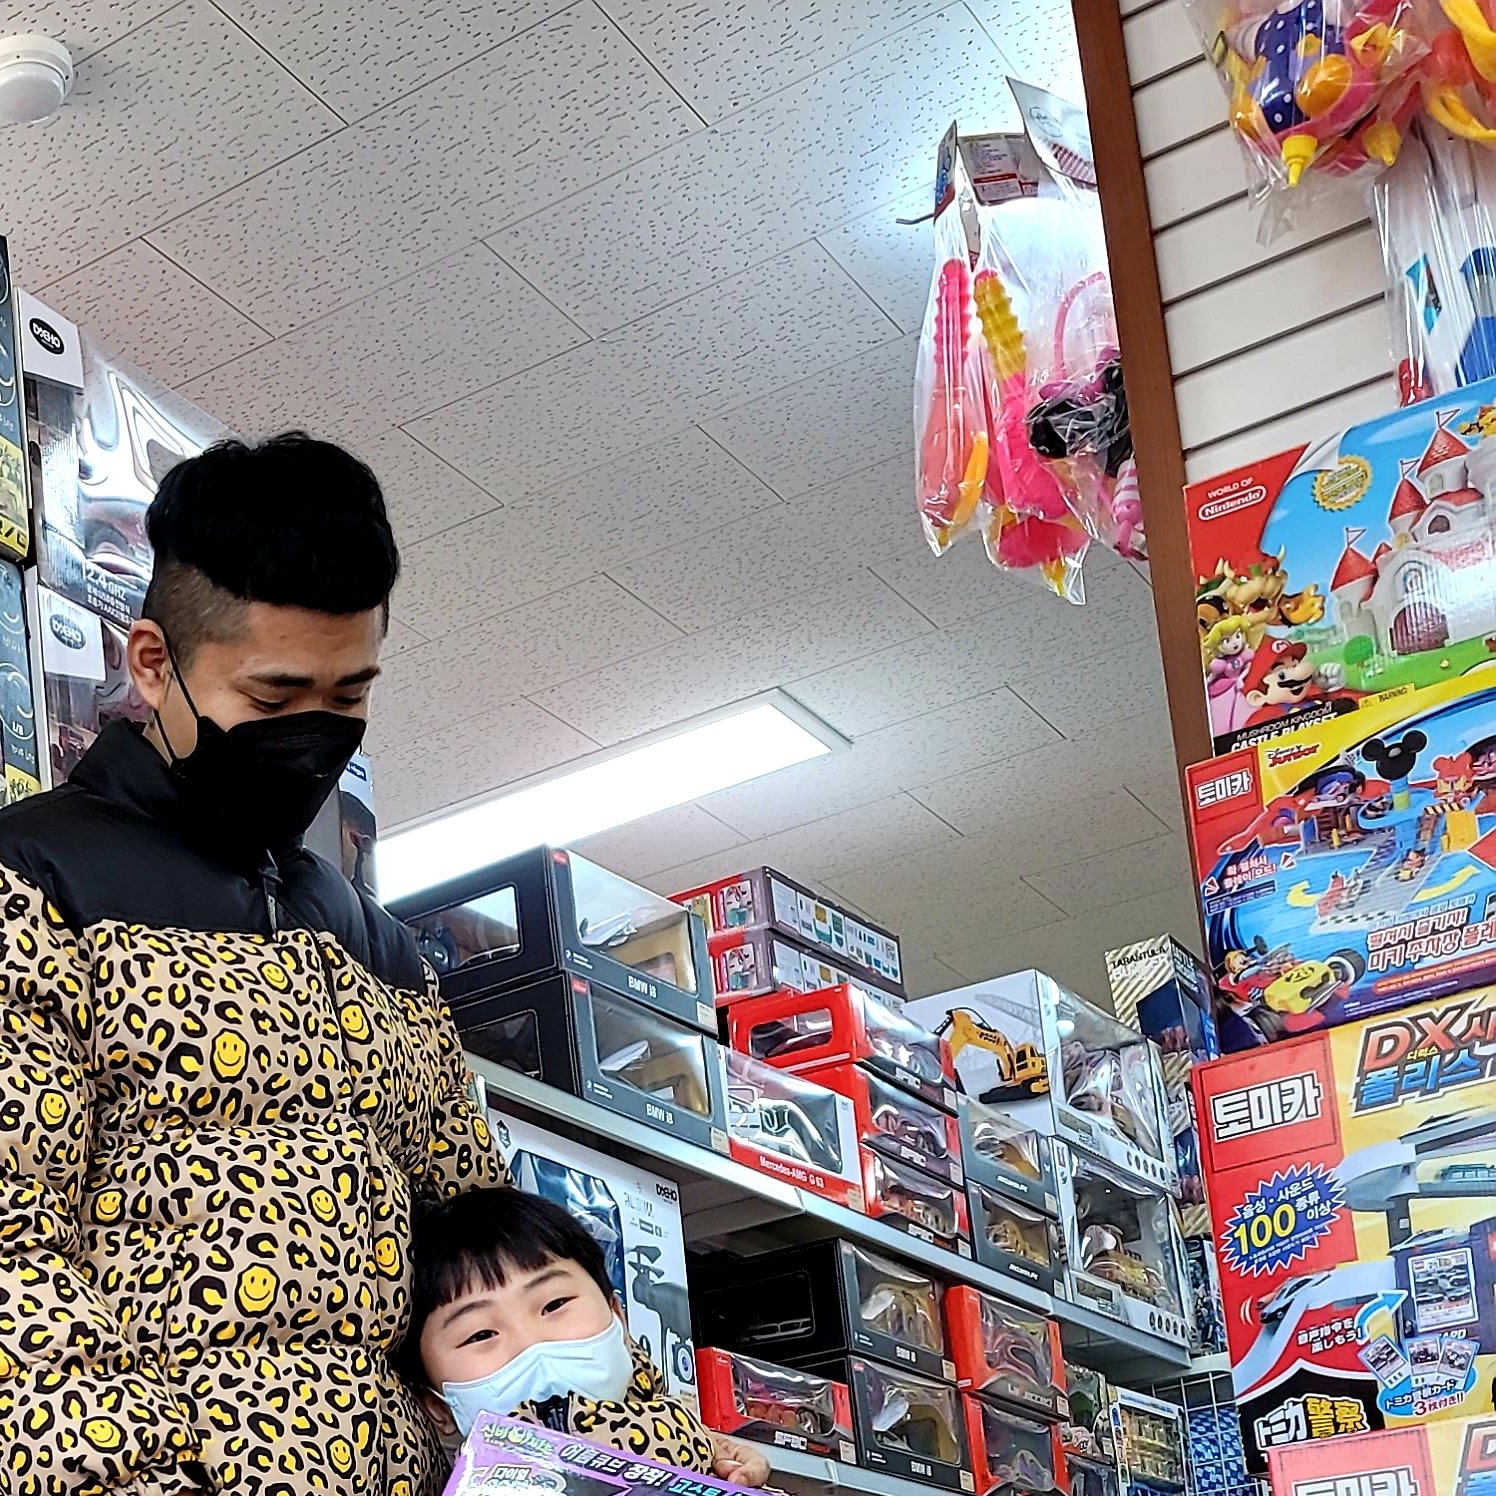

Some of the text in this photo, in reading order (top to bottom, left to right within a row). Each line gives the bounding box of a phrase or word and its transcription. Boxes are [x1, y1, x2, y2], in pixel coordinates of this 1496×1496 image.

[1204, 490, 1263, 518] Nintendo
[1208, 477, 1254, 498] WORLD OF
[1237, 703, 1332, 741] MUSHROOM KINGDOM
[1197, 769, 1251, 806] 토미카
[628, 975, 646, 994] BMW
[1365, 1001, 1464, 1070] DX
[1360, 1052, 1480, 1104] 폴리스
[646, 1103, 665, 1121] BMW
[1213, 1075, 1322, 1138] 토미카
[760, 1156, 808, 1181] Mercedes-AMG
[1243, 1177, 1315, 1219] 음성 사운드
[1296, 1193, 1320, 1211] 종류
[1307, 1203, 1332, 1223] 이상
[1235, 1204, 1296, 1253] 100
[1256, 1395, 1365, 1444] トミカ警察
[559, 1443, 626, 1474] 어둠큐브
[626, 1461, 671, 1486] 장착!
